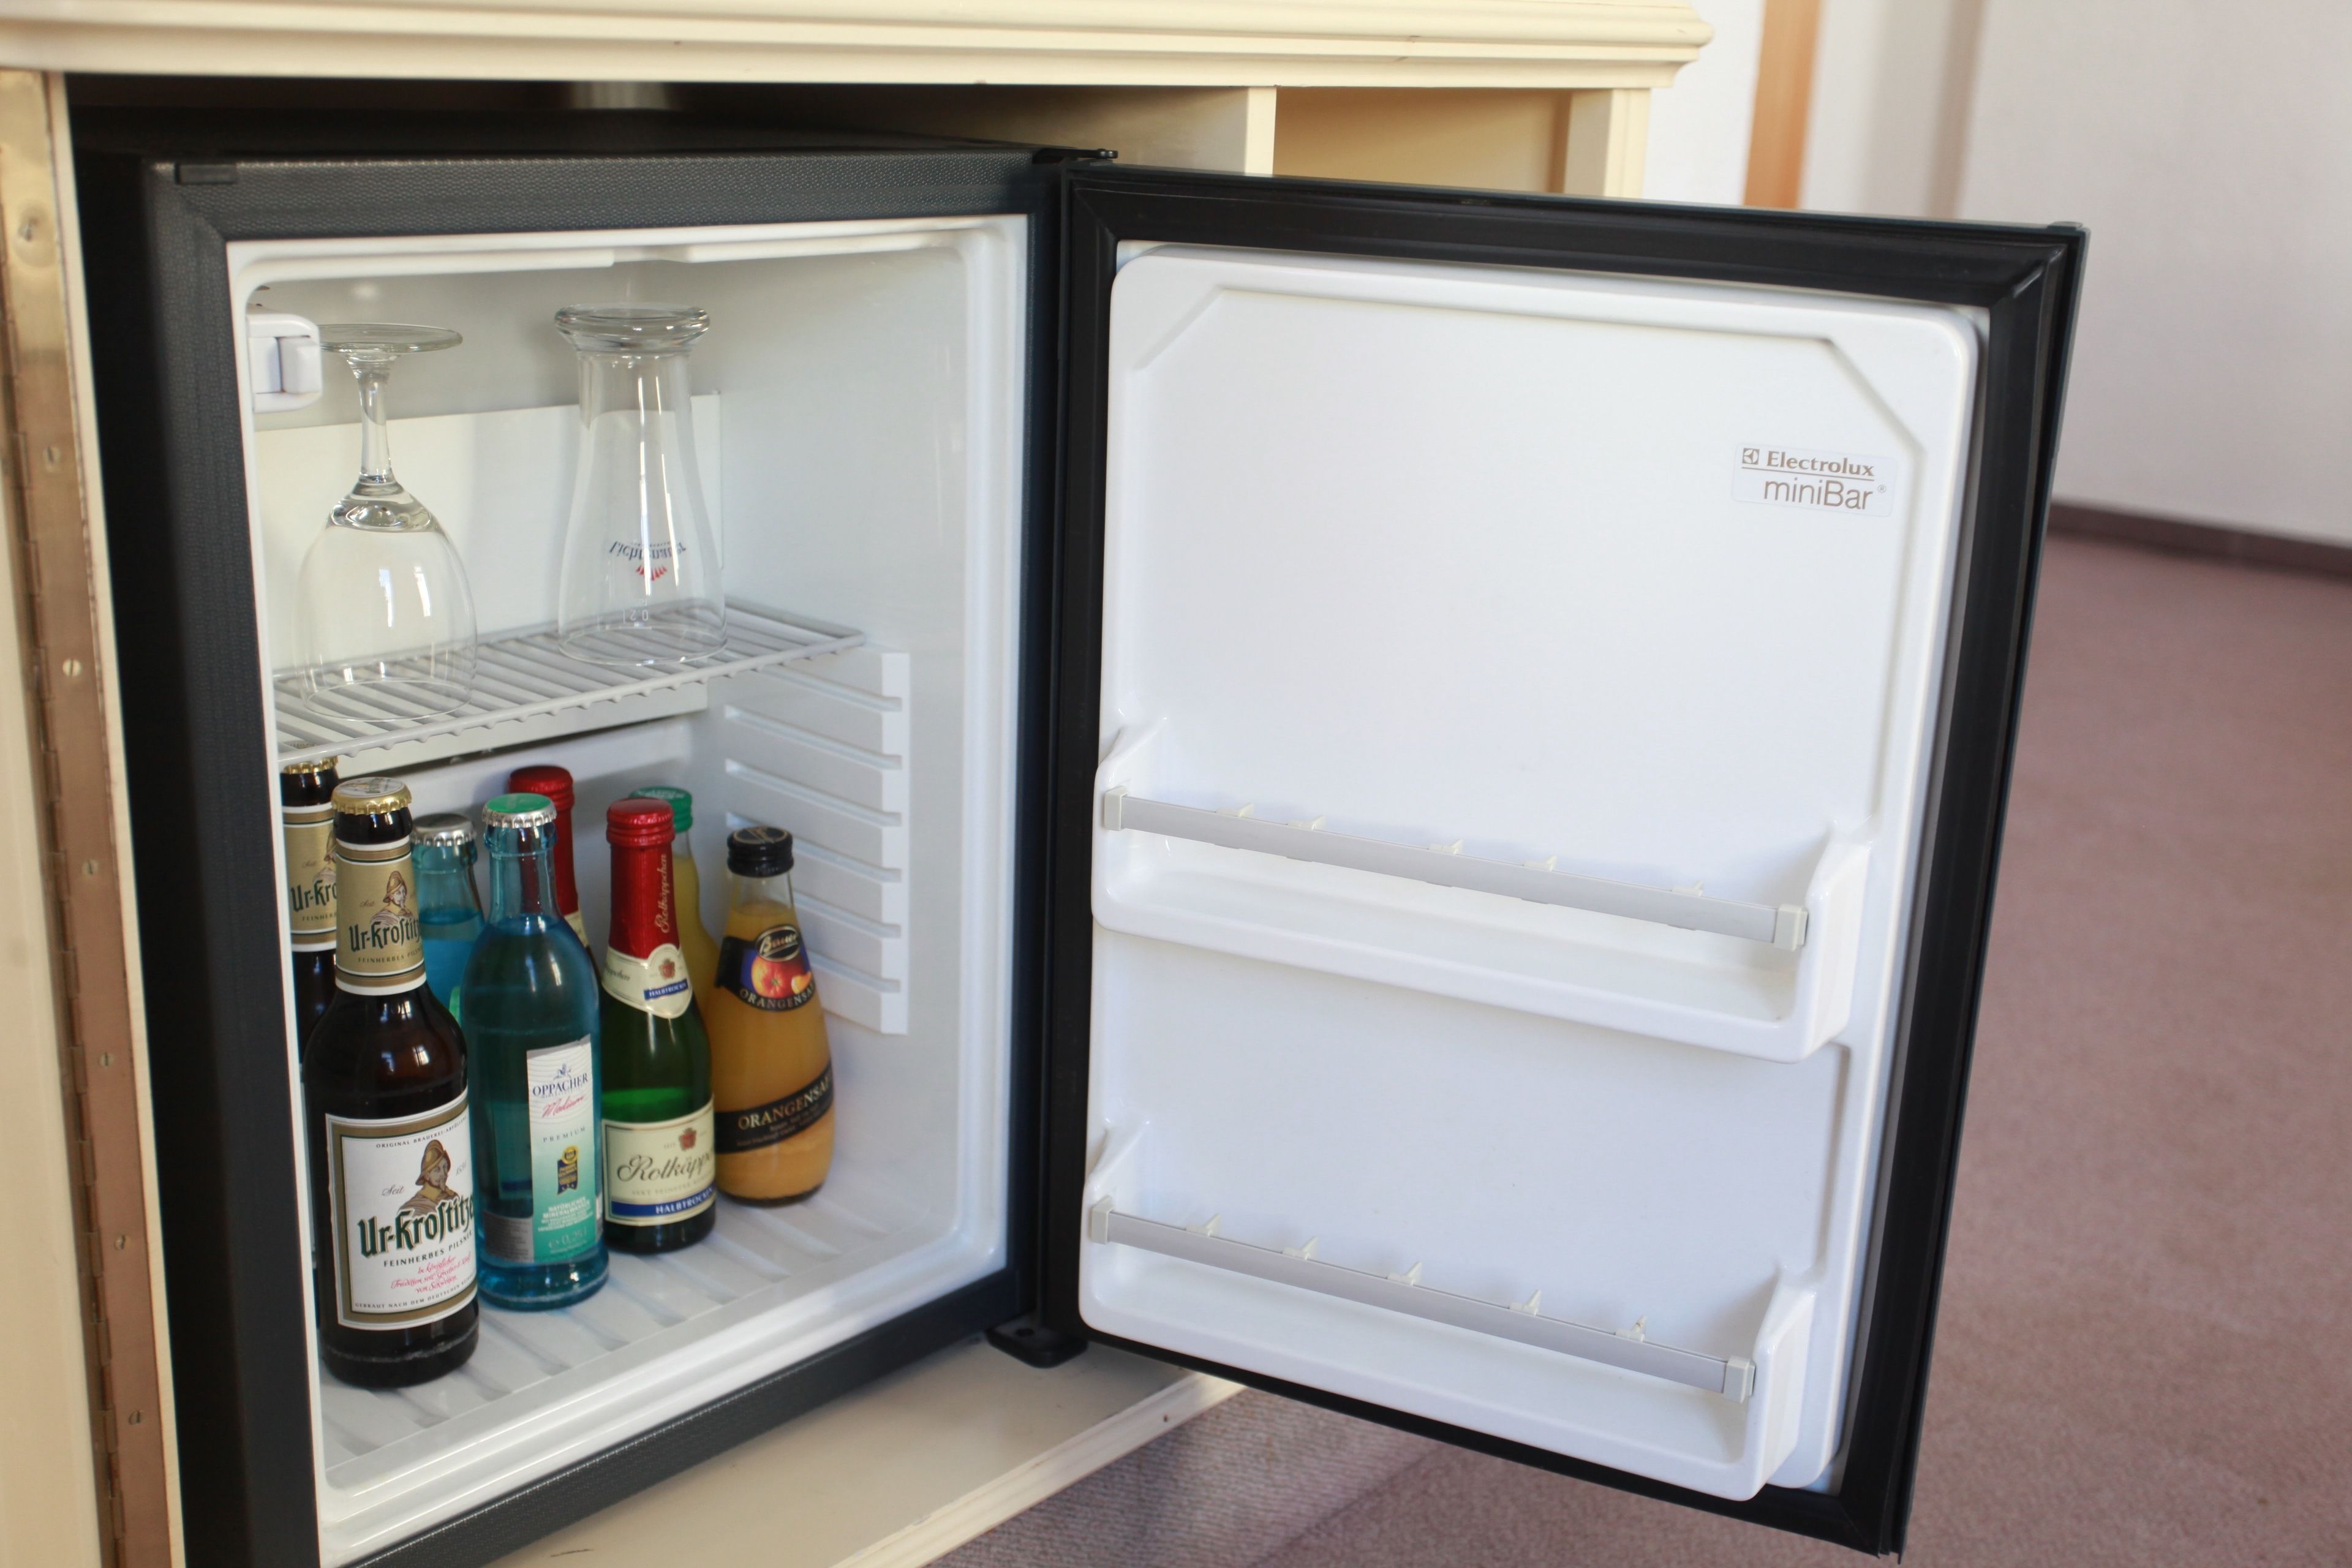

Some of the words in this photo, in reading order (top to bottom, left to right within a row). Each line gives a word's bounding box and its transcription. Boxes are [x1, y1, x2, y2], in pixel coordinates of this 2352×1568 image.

[1766, 450, 1875, 477] Electrolux
[290, 879, 337, 913] Ur-Kro
[358, 954, 405, 963] FEINHERBES
[532, 1072, 589, 1097] OPPACHER
[543, 1126, 586, 1143] PREMIUM
[384, 1250, 445, 1268] FEINHERBES
